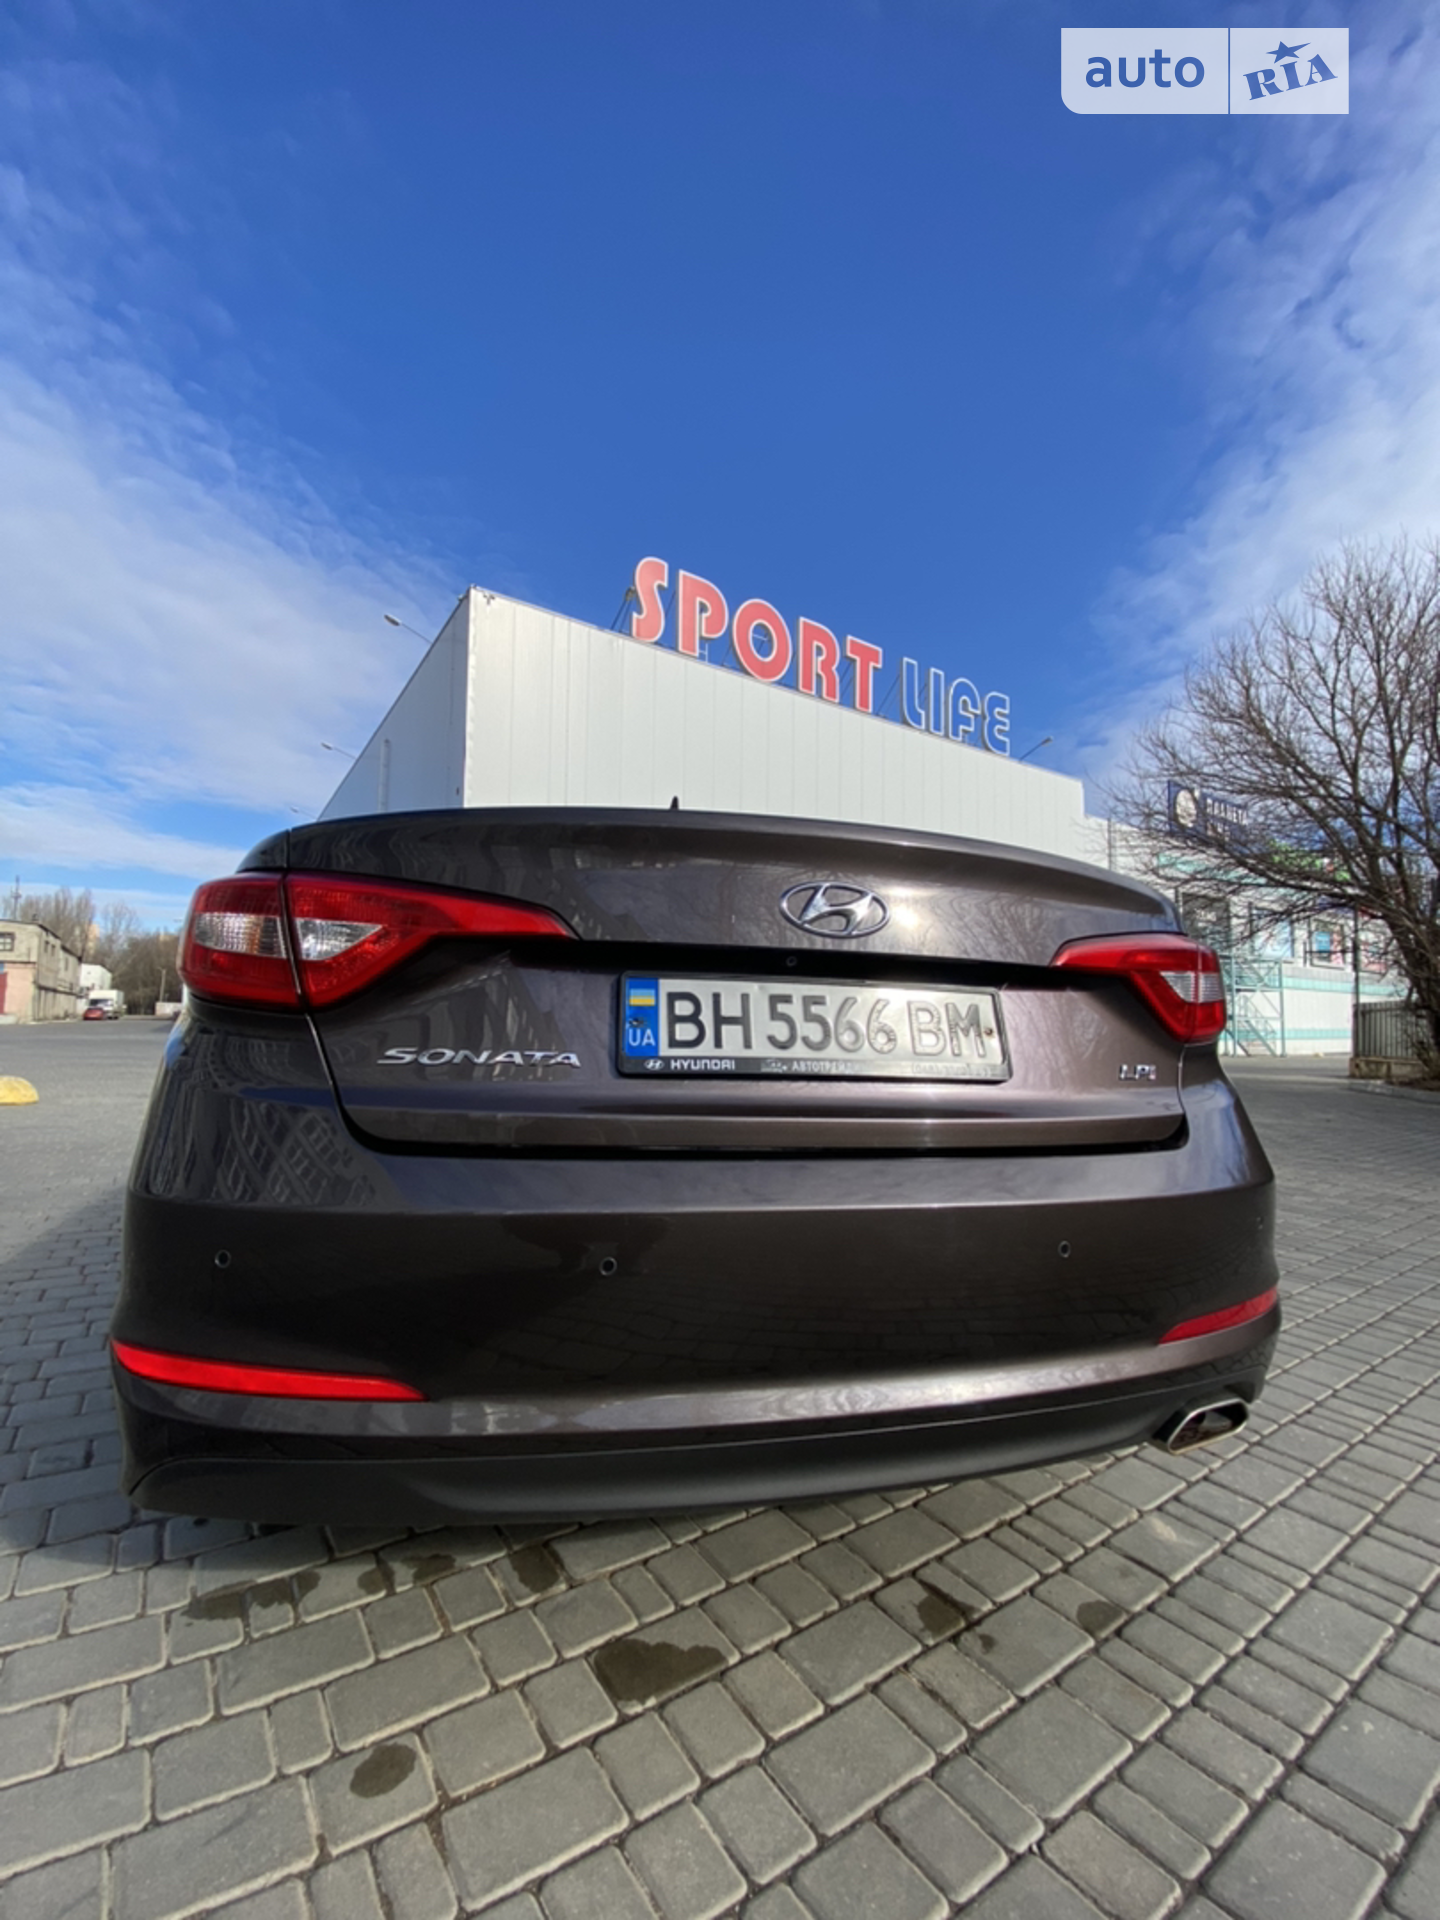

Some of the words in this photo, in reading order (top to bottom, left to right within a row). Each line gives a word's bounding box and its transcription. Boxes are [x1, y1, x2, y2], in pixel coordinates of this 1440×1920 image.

[632, 556, 883, 713] SPORT
[902, 657, 1010, 756] LIFE
[666, 991, 753, 1050] BH
[767, 994, 898, 1055] 5566
[907, 1000, 988, 1058] BM
[628, 1028, 656, 1047] UA
[377, 1047, 581, 1067] SONATA
[670, 1059, 736, 1071] HYUNDAI
